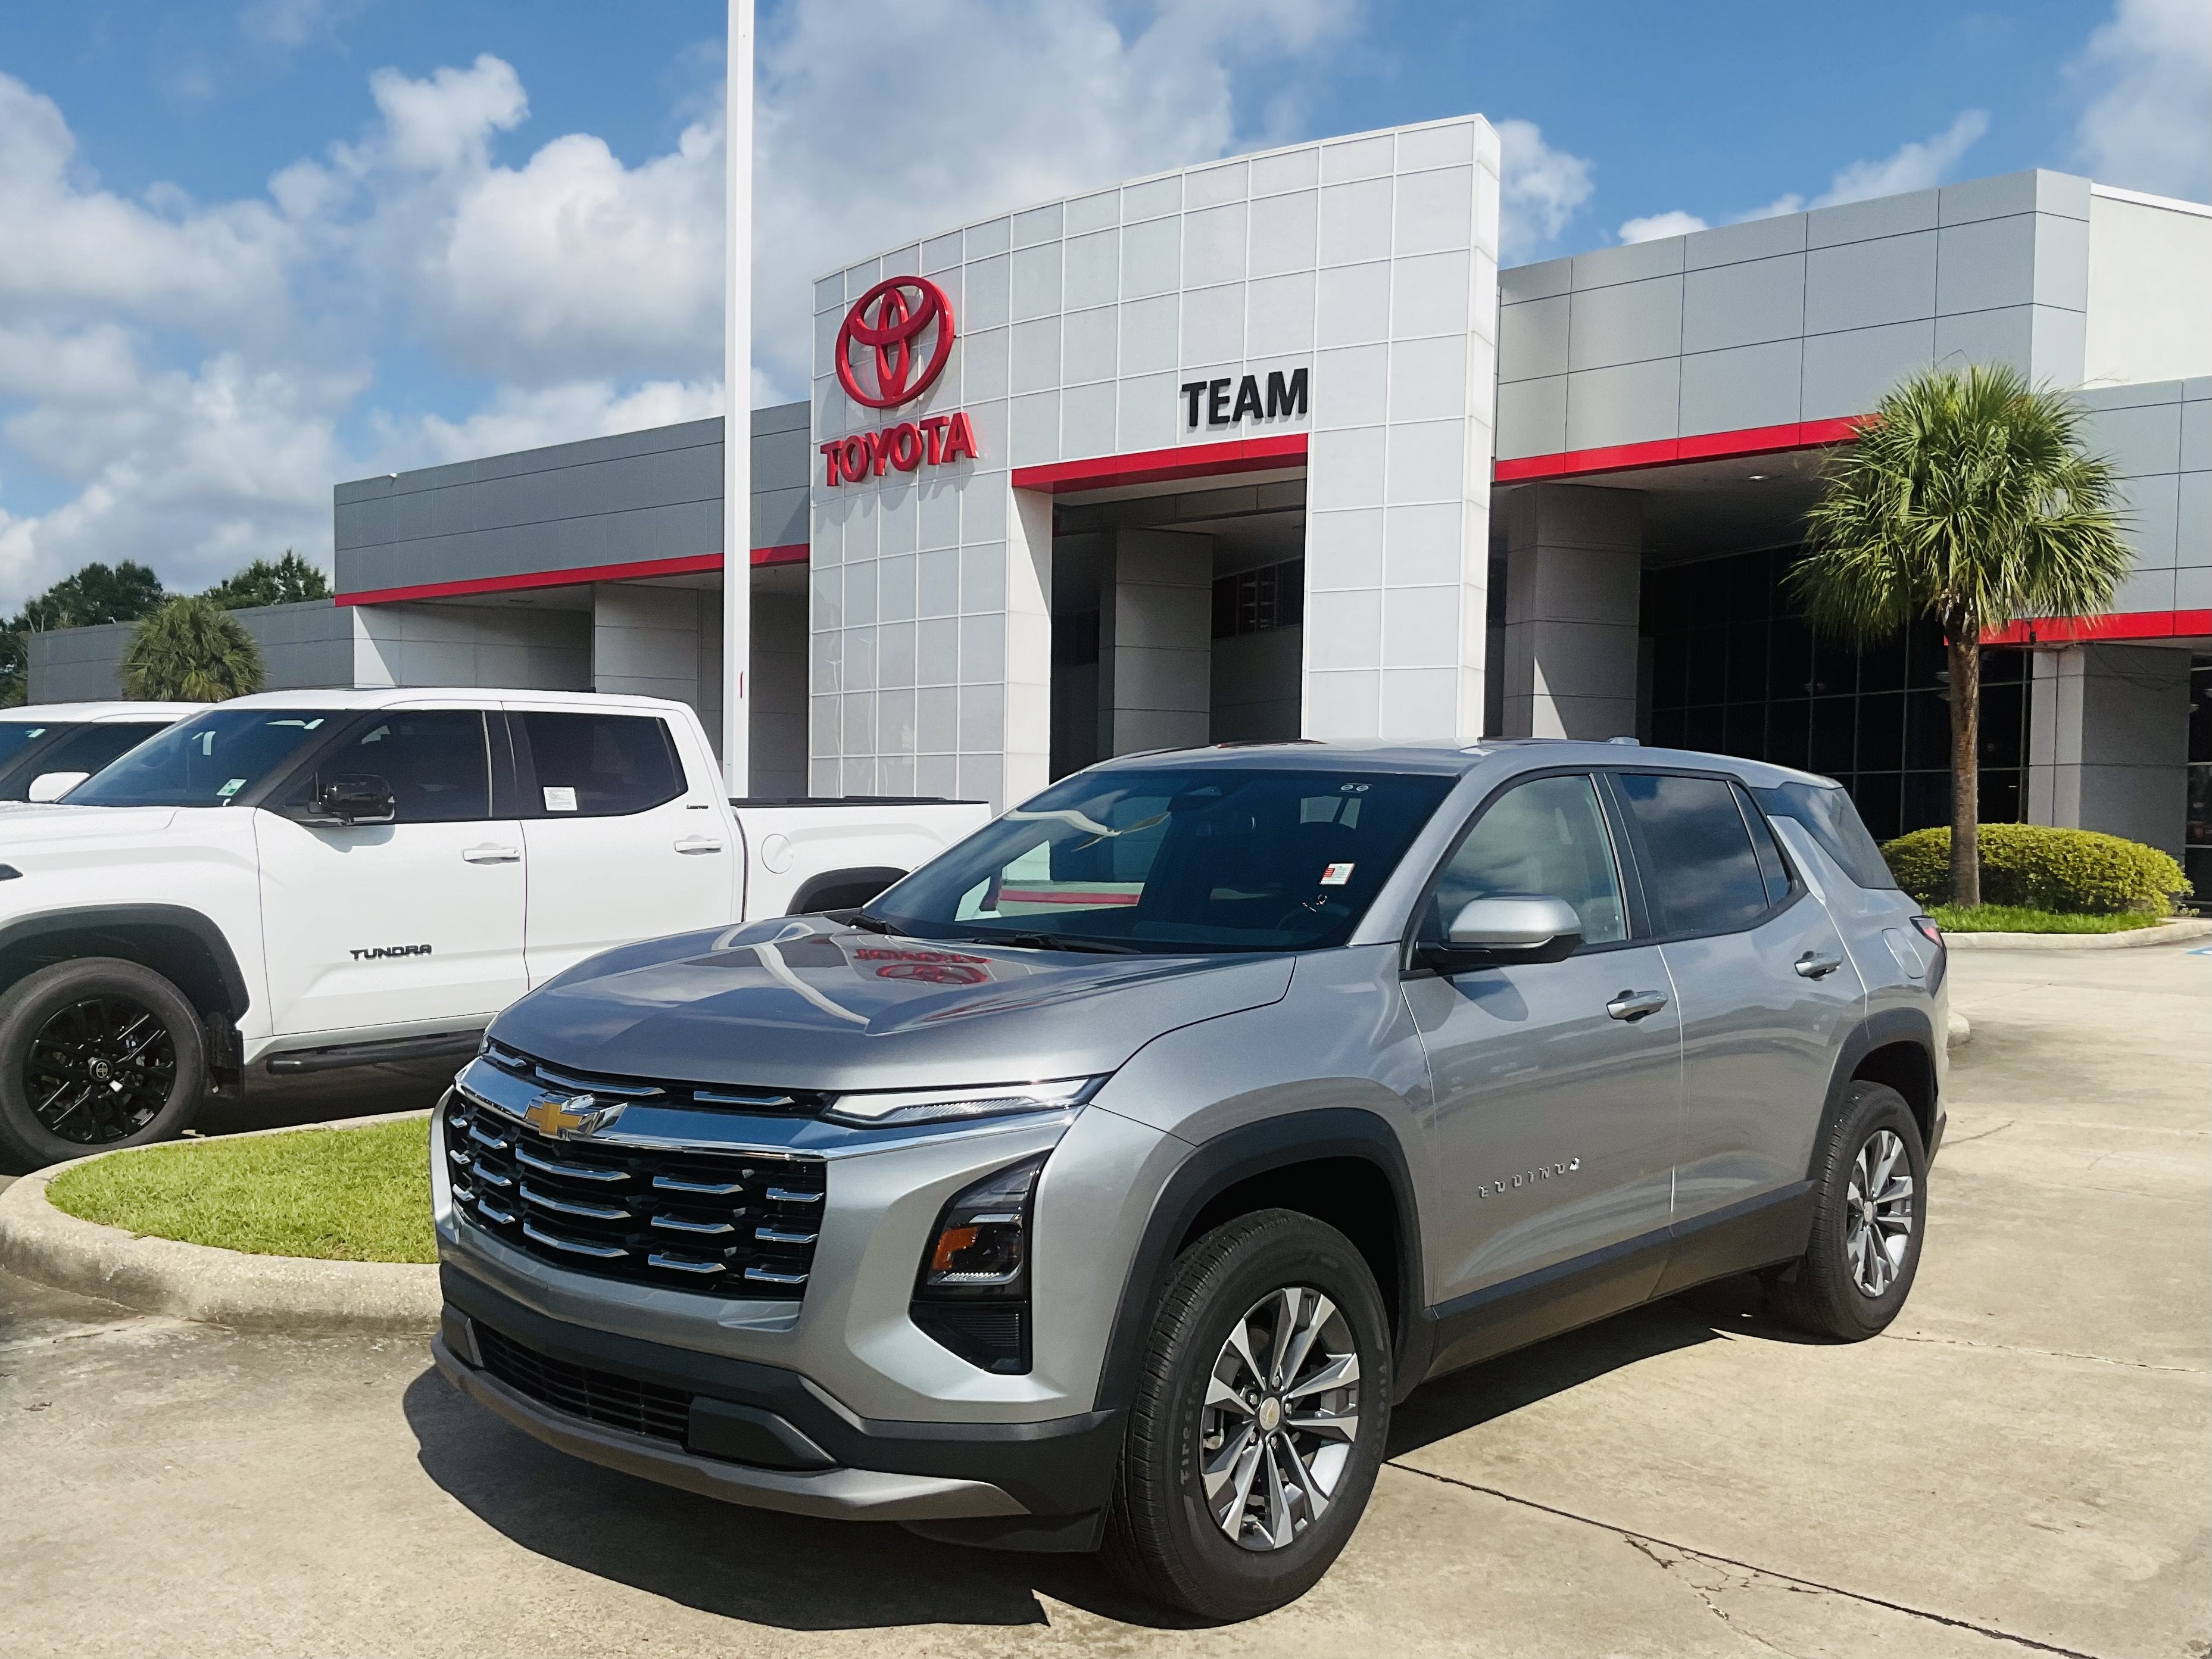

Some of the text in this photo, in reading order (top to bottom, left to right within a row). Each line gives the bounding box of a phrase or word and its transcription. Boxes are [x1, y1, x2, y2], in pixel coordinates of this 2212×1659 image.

[1181, 367, 1308, 426] TEAM
[820, 411, 979, 487] TOYOTA
[350, 944, 432, 961] TUNDRA
